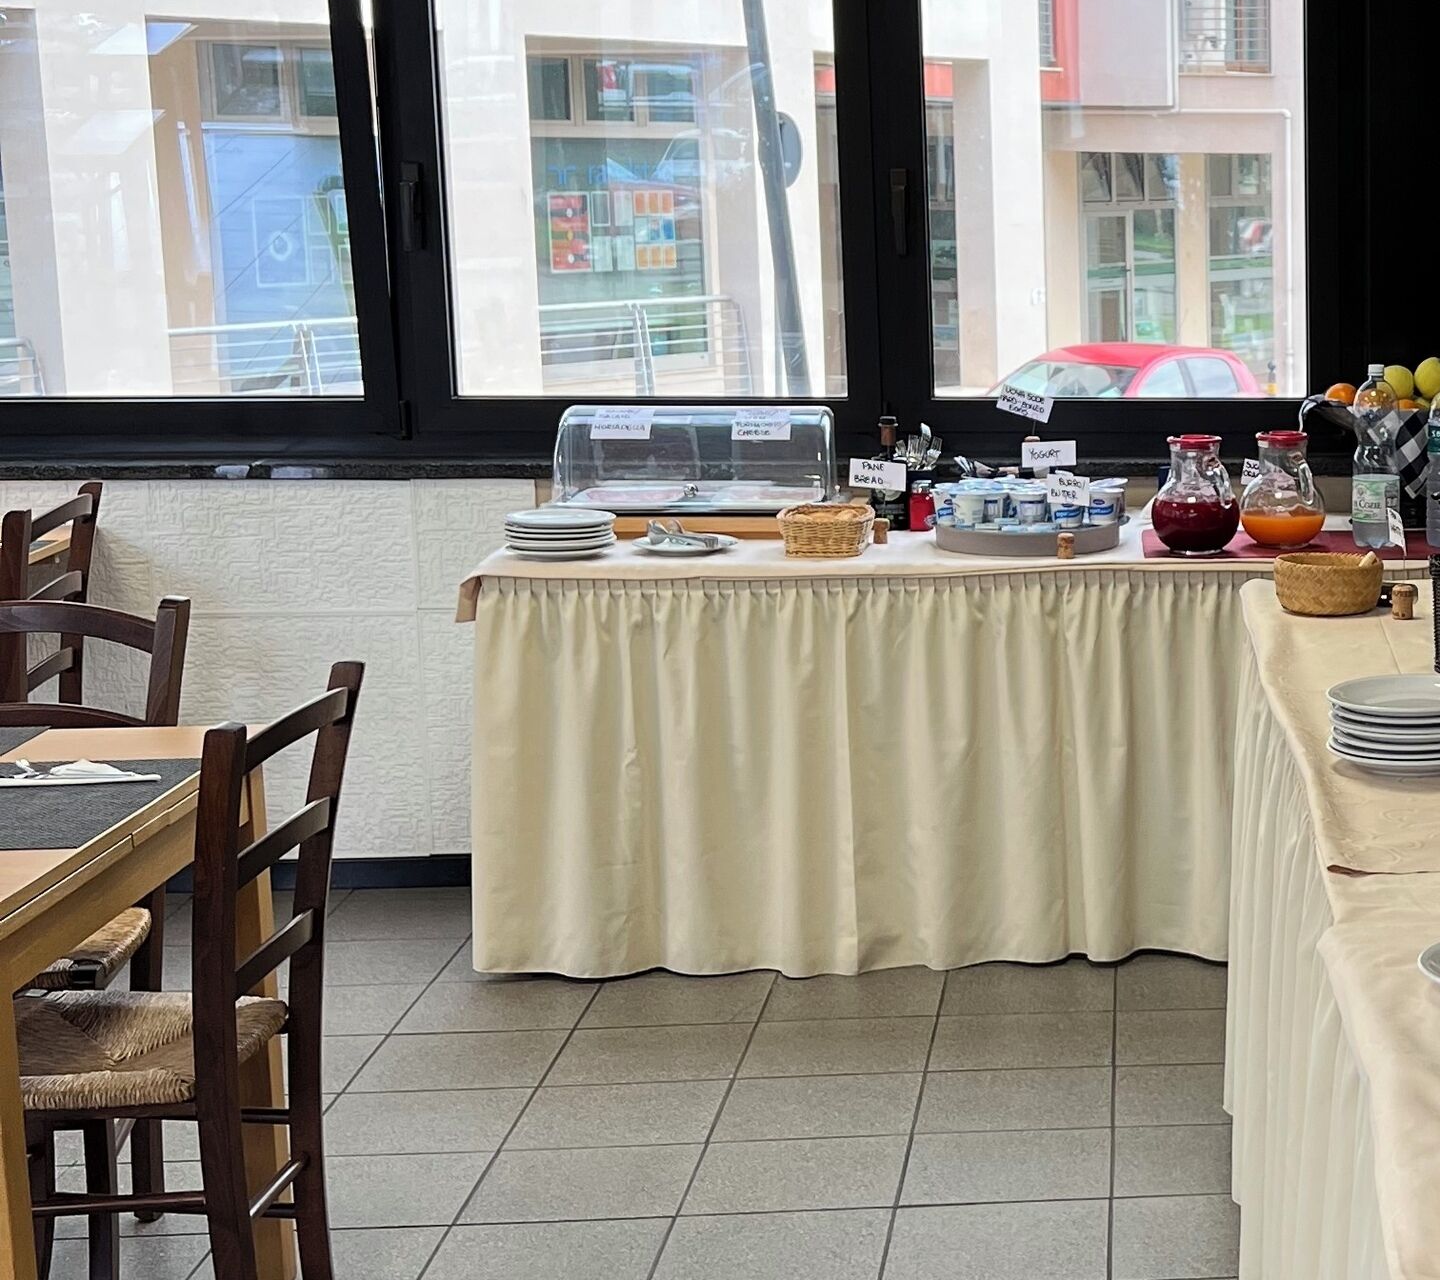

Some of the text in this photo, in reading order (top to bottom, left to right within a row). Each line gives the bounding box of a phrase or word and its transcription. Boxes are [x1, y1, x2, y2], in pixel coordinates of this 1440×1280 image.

[1030, 448, 1061, 460] YOGURT
[862, 461, 885, 471] PANE
[854, 474, 884, 484] BREAD
